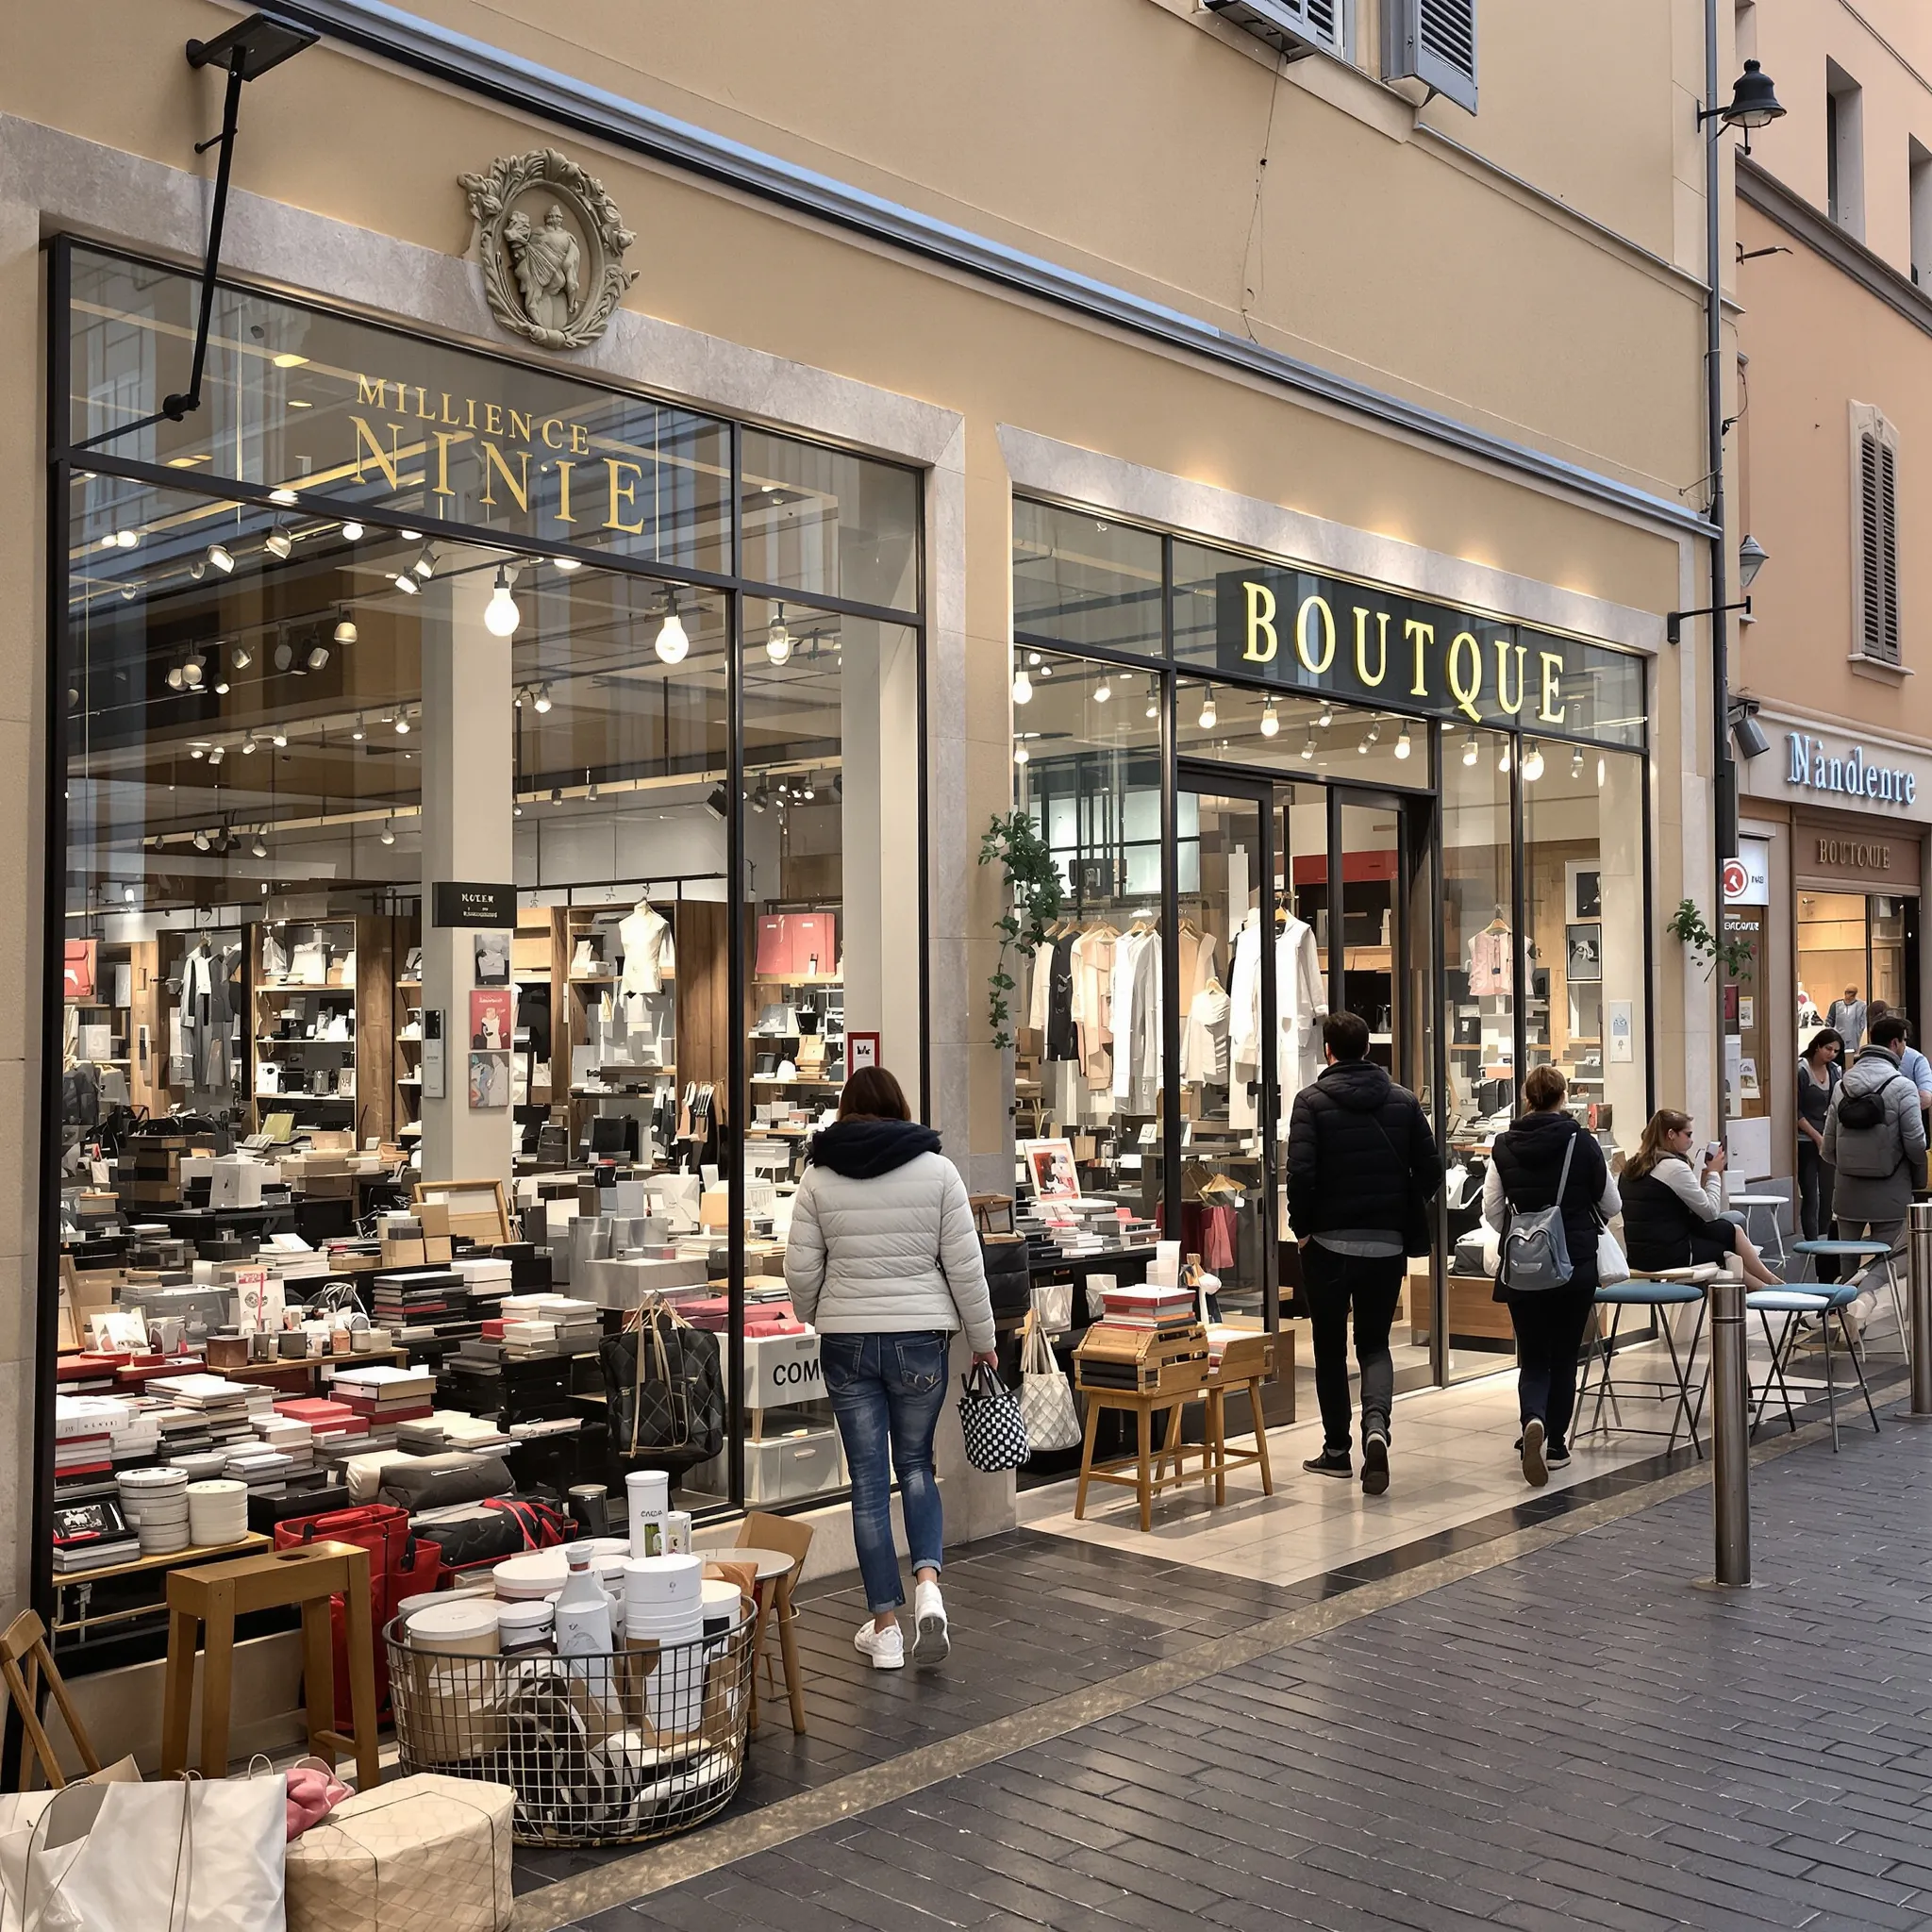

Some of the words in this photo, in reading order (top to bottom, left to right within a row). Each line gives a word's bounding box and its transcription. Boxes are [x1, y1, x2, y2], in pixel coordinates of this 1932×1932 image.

[357, 374, 591, 456] MILLIENCE
[1242, 581, 1565, 724] BOUTQUE
[774, 1358, 820, 1386] COM
